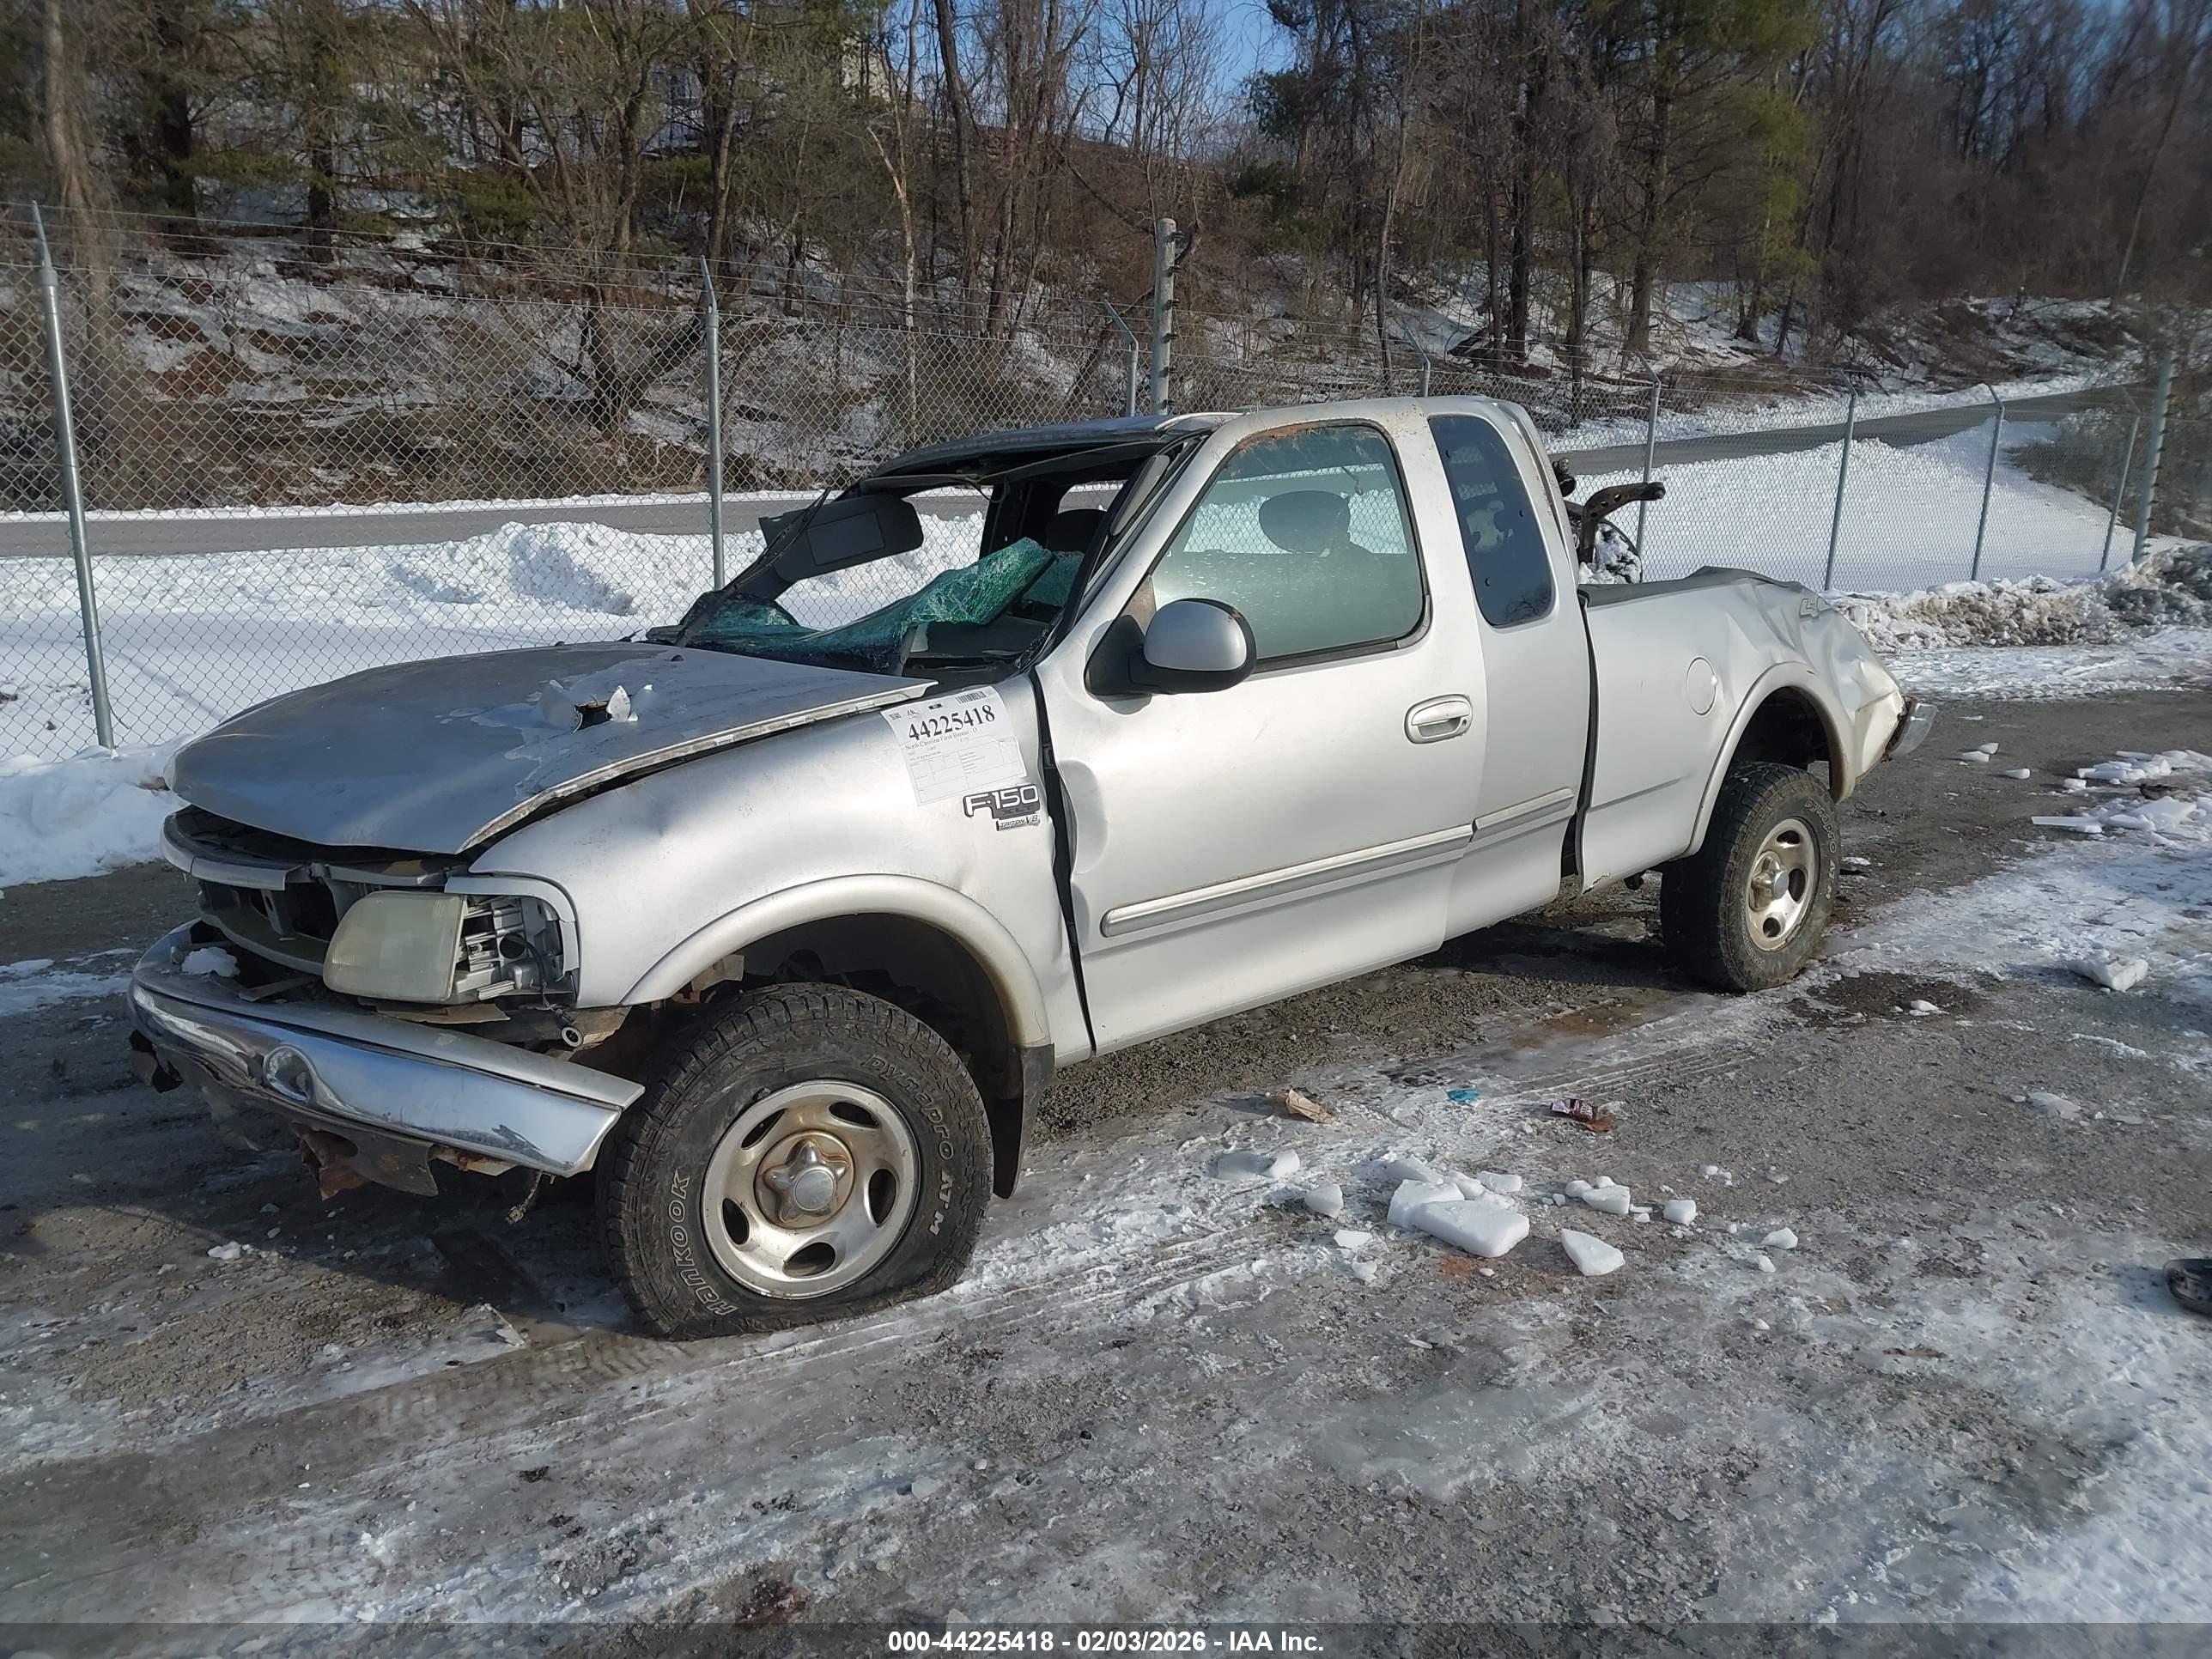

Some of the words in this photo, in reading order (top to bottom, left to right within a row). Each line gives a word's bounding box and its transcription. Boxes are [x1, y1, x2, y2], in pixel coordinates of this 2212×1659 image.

[908, 704, 995, 740] 44225418
[905, 742, 920, 750] North
[920, 737, 940, 748] Carolina
[965, 785, 1039, 816] F-150
